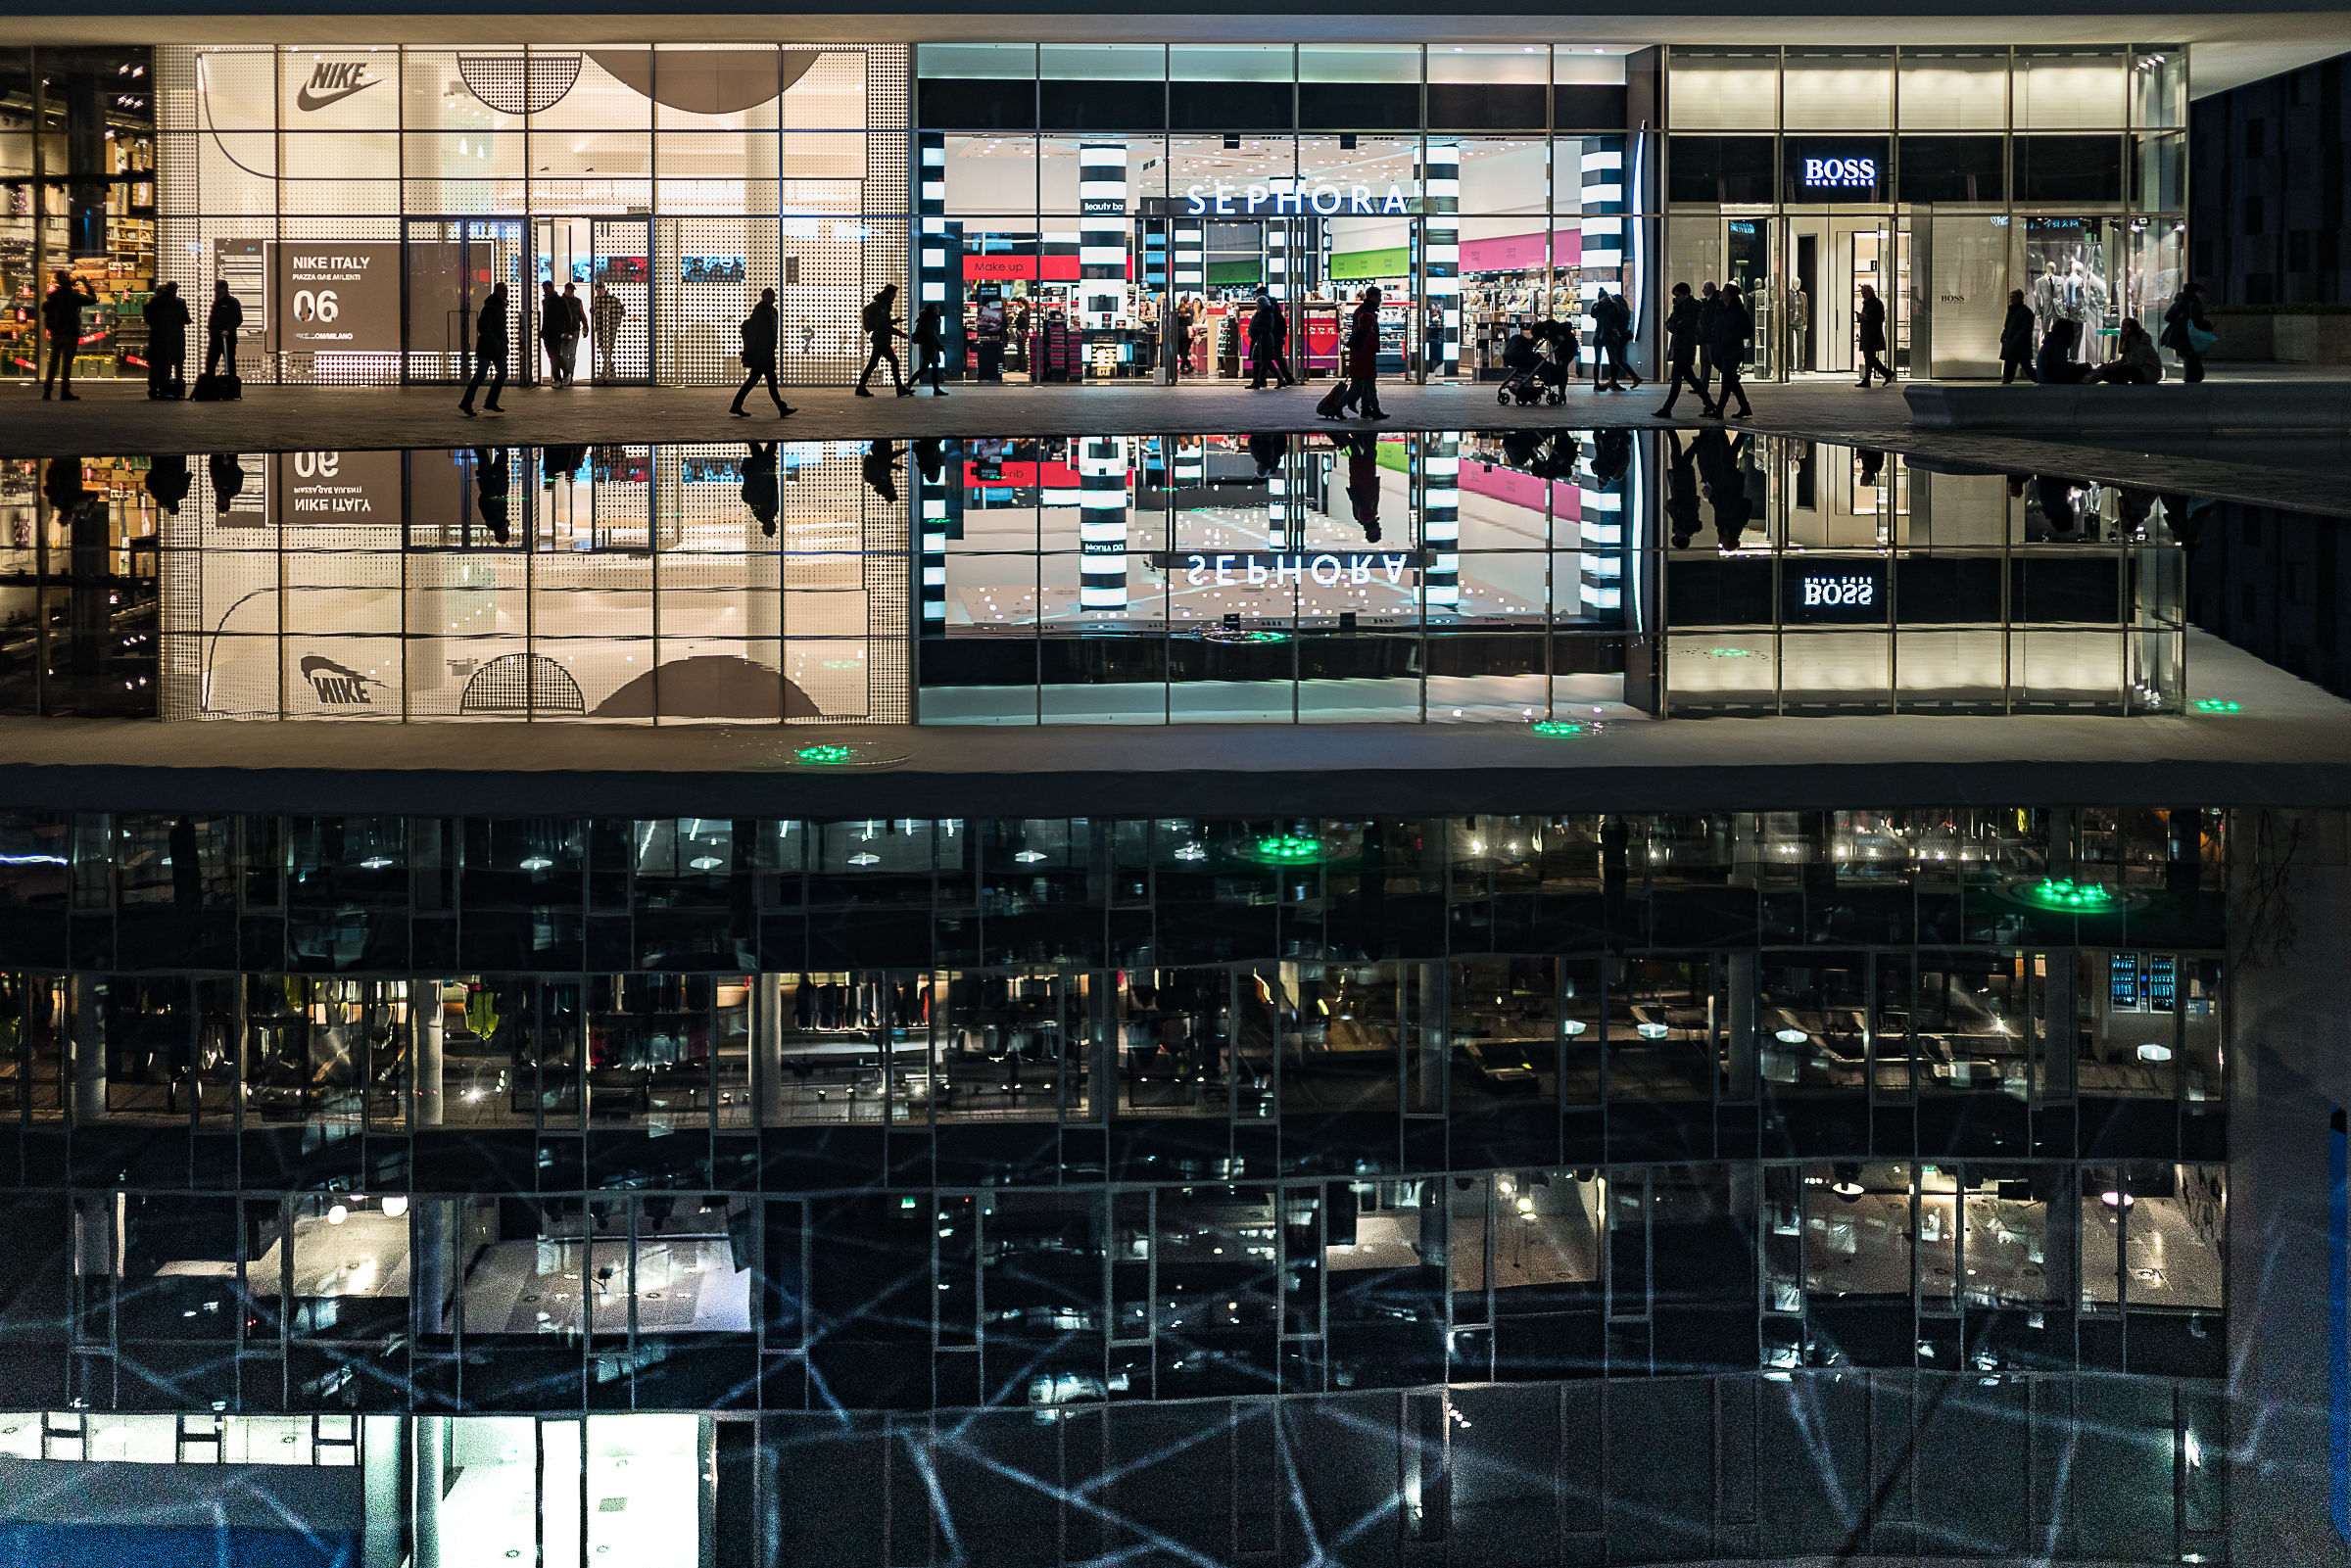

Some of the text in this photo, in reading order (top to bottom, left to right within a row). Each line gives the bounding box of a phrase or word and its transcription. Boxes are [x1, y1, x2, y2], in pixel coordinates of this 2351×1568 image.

[309, 63, 367, 88] NIKE
[1805, 158, 1876, 179] BOSS
[1084, 202, 1124, 211] Beauty bar
[1187, 184, 1408, 214] SEPHORA
[293, 257, 370, 269] NIKE ITALY
[975, 261, 1024, 273] Make up
[293, 290, 339, 323] 06
